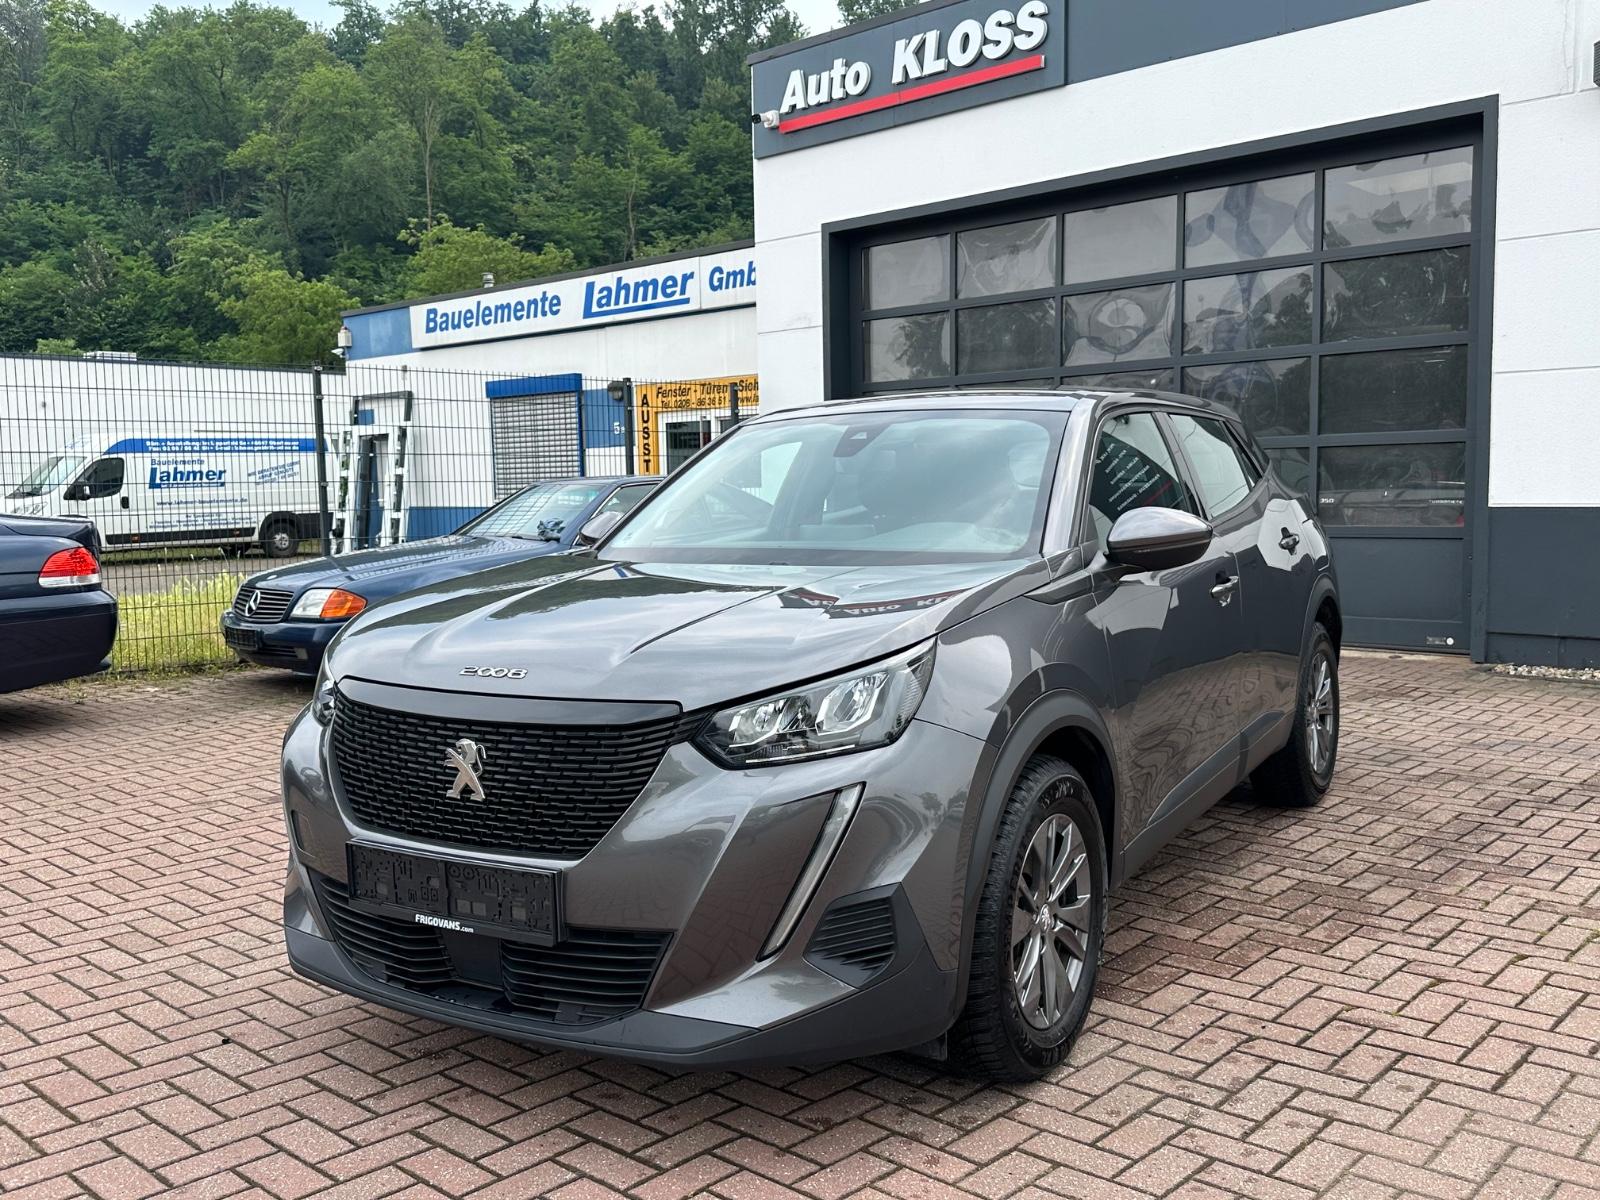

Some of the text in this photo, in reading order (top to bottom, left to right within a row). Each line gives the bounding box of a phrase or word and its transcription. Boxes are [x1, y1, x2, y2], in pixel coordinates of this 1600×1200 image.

[779, 0, 1048, 114] Auto KLOSS
[425, 290, 561, 334] Bauelemente
[582, 270, 695, 319] Lahmer
[656, 386, 691, 399] Fenster
[701, 383, 728, 395] Türen
[640, 393, 652, 473] AUSST
[151, 458, 205, 466] Bauelemente
[149, 467, 227, 489] Lahmer
[459, 665, 528, 680] 2008
[414, 913, 474, 933] FRIGOVANS.com
